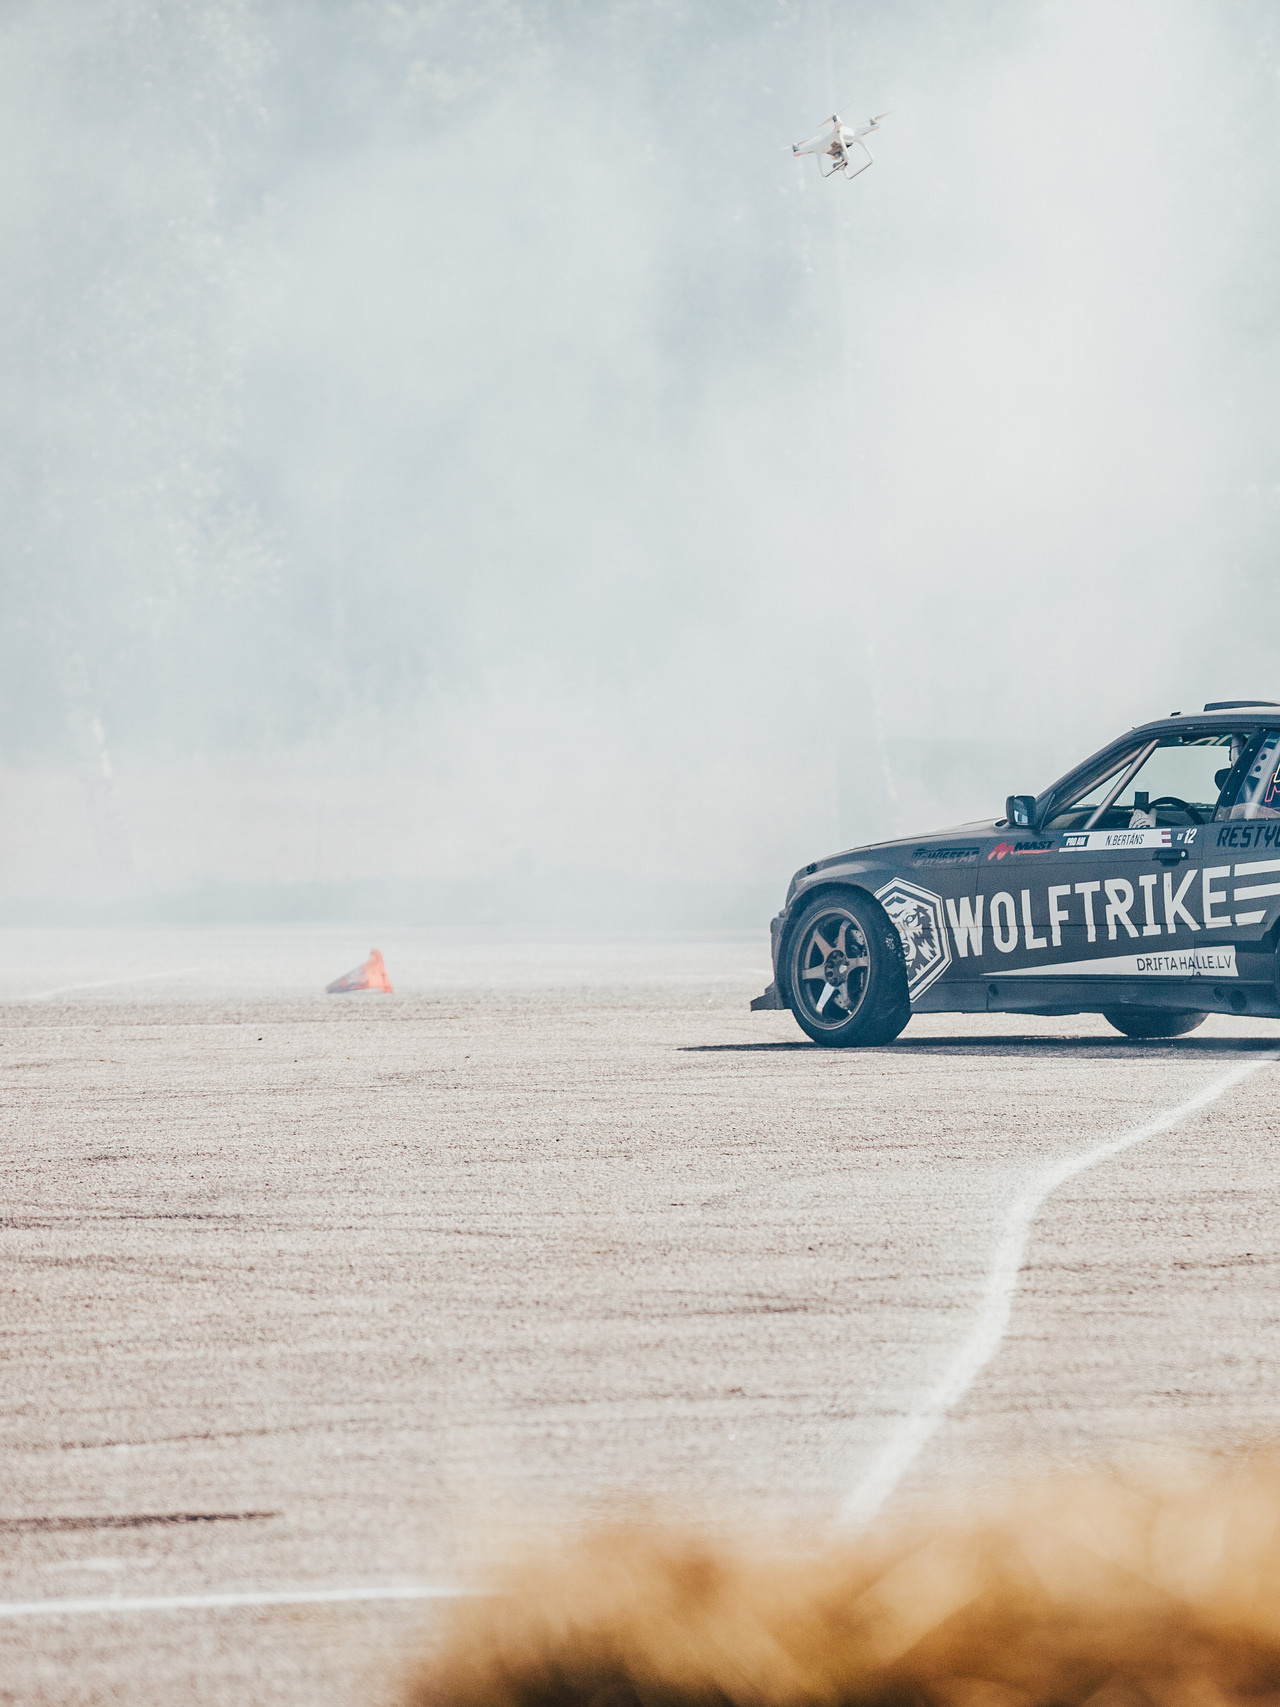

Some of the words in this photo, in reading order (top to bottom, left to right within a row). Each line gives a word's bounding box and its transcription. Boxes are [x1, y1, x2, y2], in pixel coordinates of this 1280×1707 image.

[1184, 828, 1197, 844] 12
[1013, 840, 1056, 850] MAST
[945, 865, 1233, 958] WOLFTRIKE
